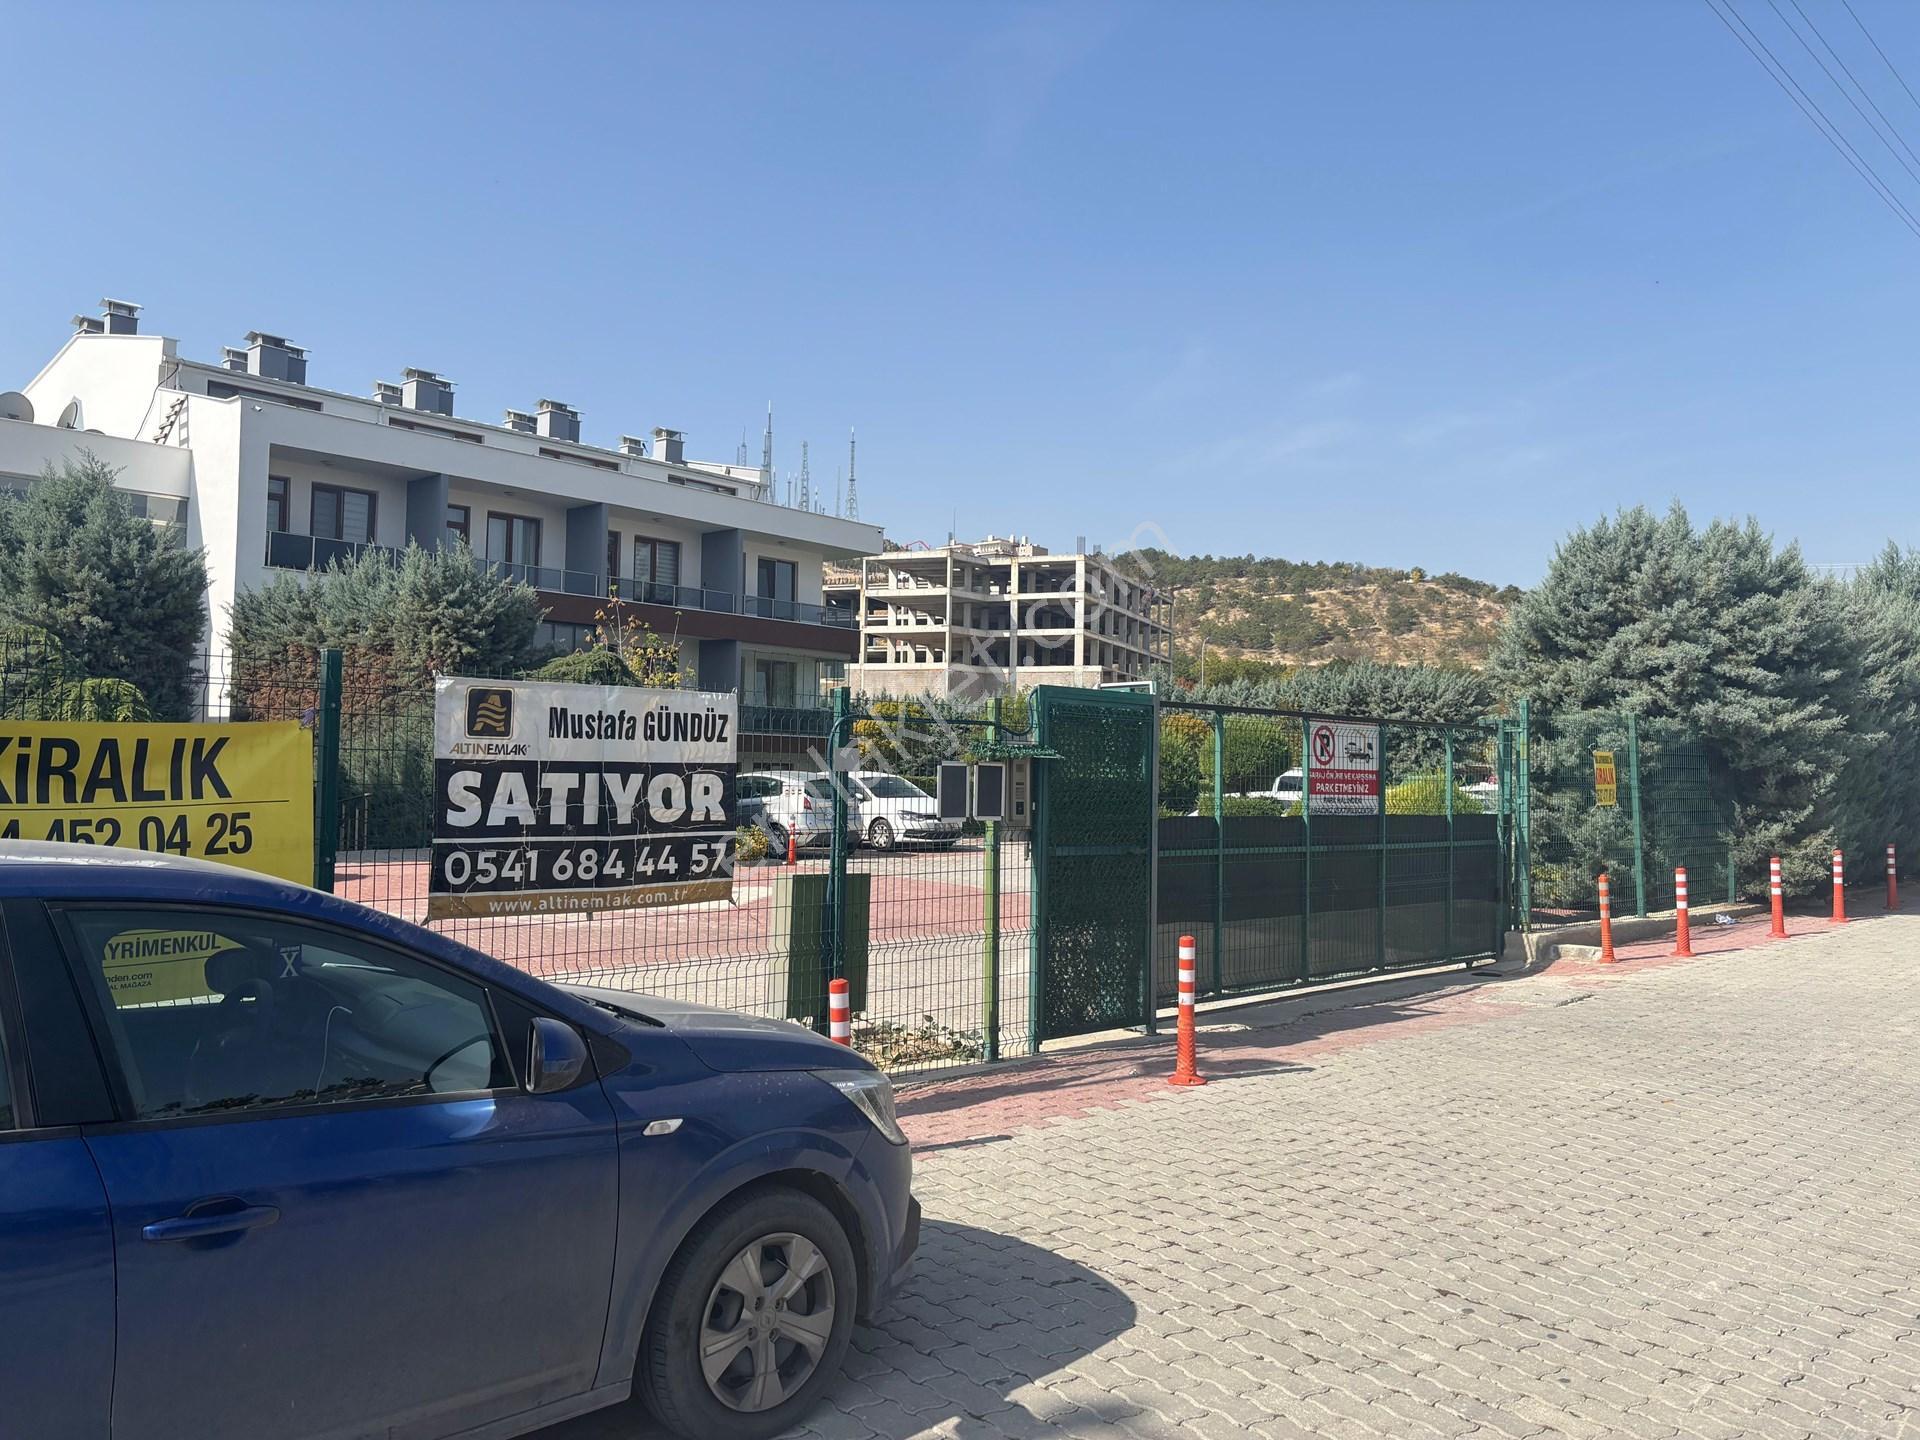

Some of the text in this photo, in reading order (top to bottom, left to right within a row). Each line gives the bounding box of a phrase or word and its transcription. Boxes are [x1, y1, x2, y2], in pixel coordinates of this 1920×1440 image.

[549, 705, 729, 743] Mustafa GÜNDÜZ
[445, 769, 727, 828] SATIYOR
[1316, 782, 1334, 793] PARK
[138, 815, 191, 857] 04
[204, 811, 252, 856] 25
[444, 843, 727, 885] 0541 684 44 57
[488, 888, 688, 913] www.altinemlak.com.tr
